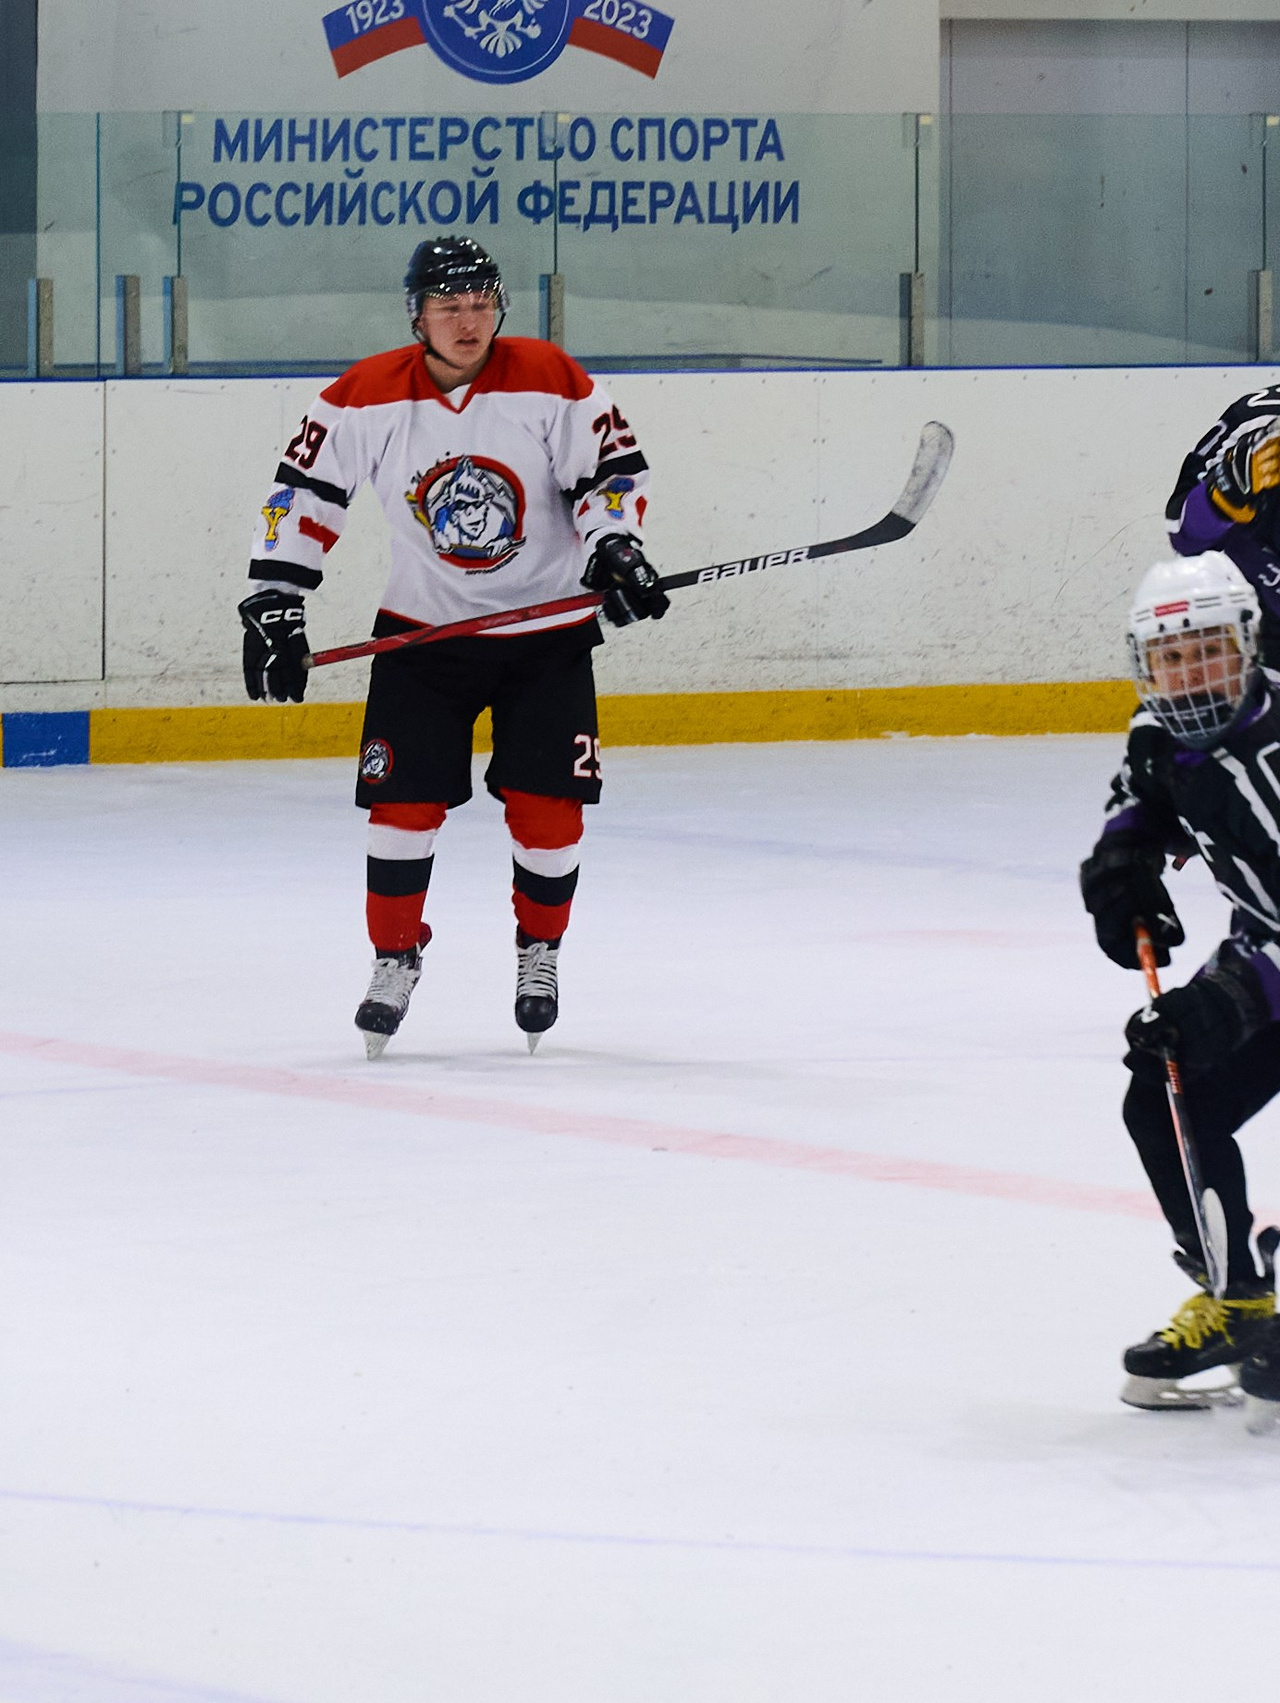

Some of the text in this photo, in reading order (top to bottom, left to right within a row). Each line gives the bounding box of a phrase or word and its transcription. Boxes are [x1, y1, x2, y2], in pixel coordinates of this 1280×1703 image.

[345, 0, 405, 34] 1923
[583, 0, 652, 39] 2023
[610, 117, 785, 162] СПОРТА
[172, 165, 799, 233] РОССИЙСКОЙ ФЕДЕРАЦИИ
[284, 414, 328, 470] 29
[697, 547, 810, 583] BAUER
